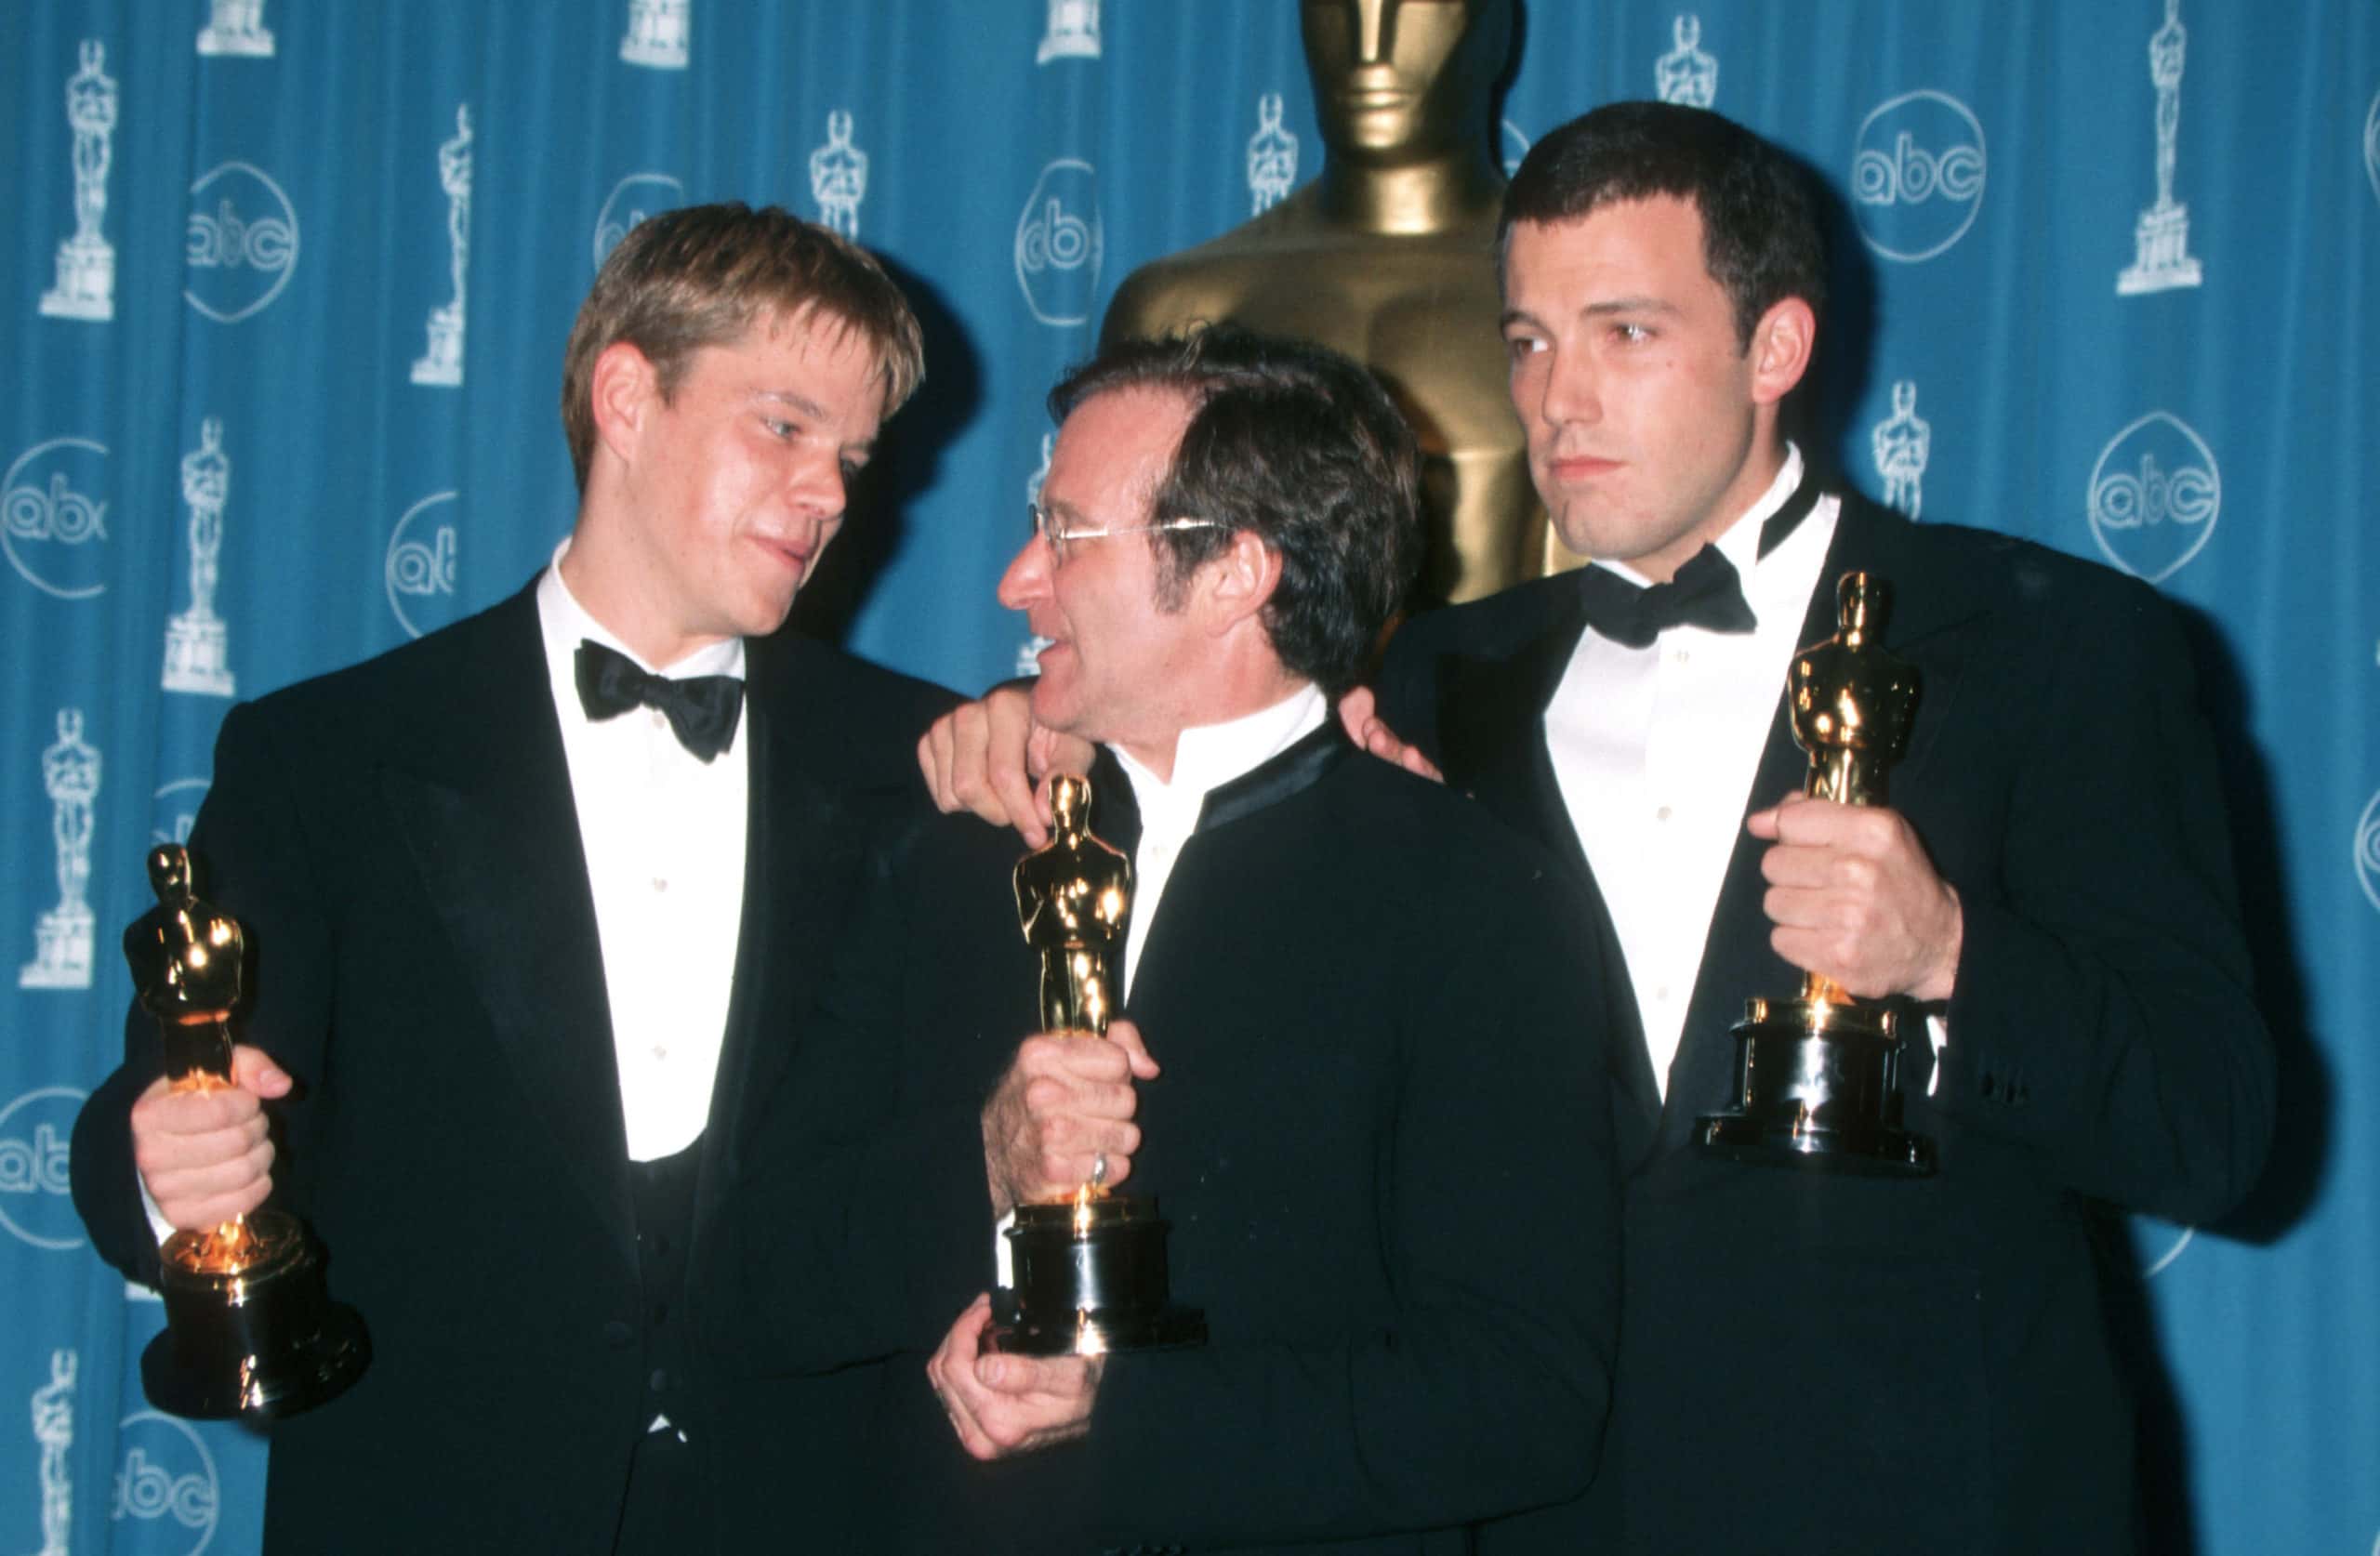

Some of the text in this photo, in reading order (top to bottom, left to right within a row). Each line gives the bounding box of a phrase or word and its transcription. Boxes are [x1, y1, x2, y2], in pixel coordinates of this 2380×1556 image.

[1855, 130, 1983, 205] abc
[1022, 197, 1091, 273] ab
[2094, 450, 2216, 530] abc
[0, 1123, 72, 1194] ab
